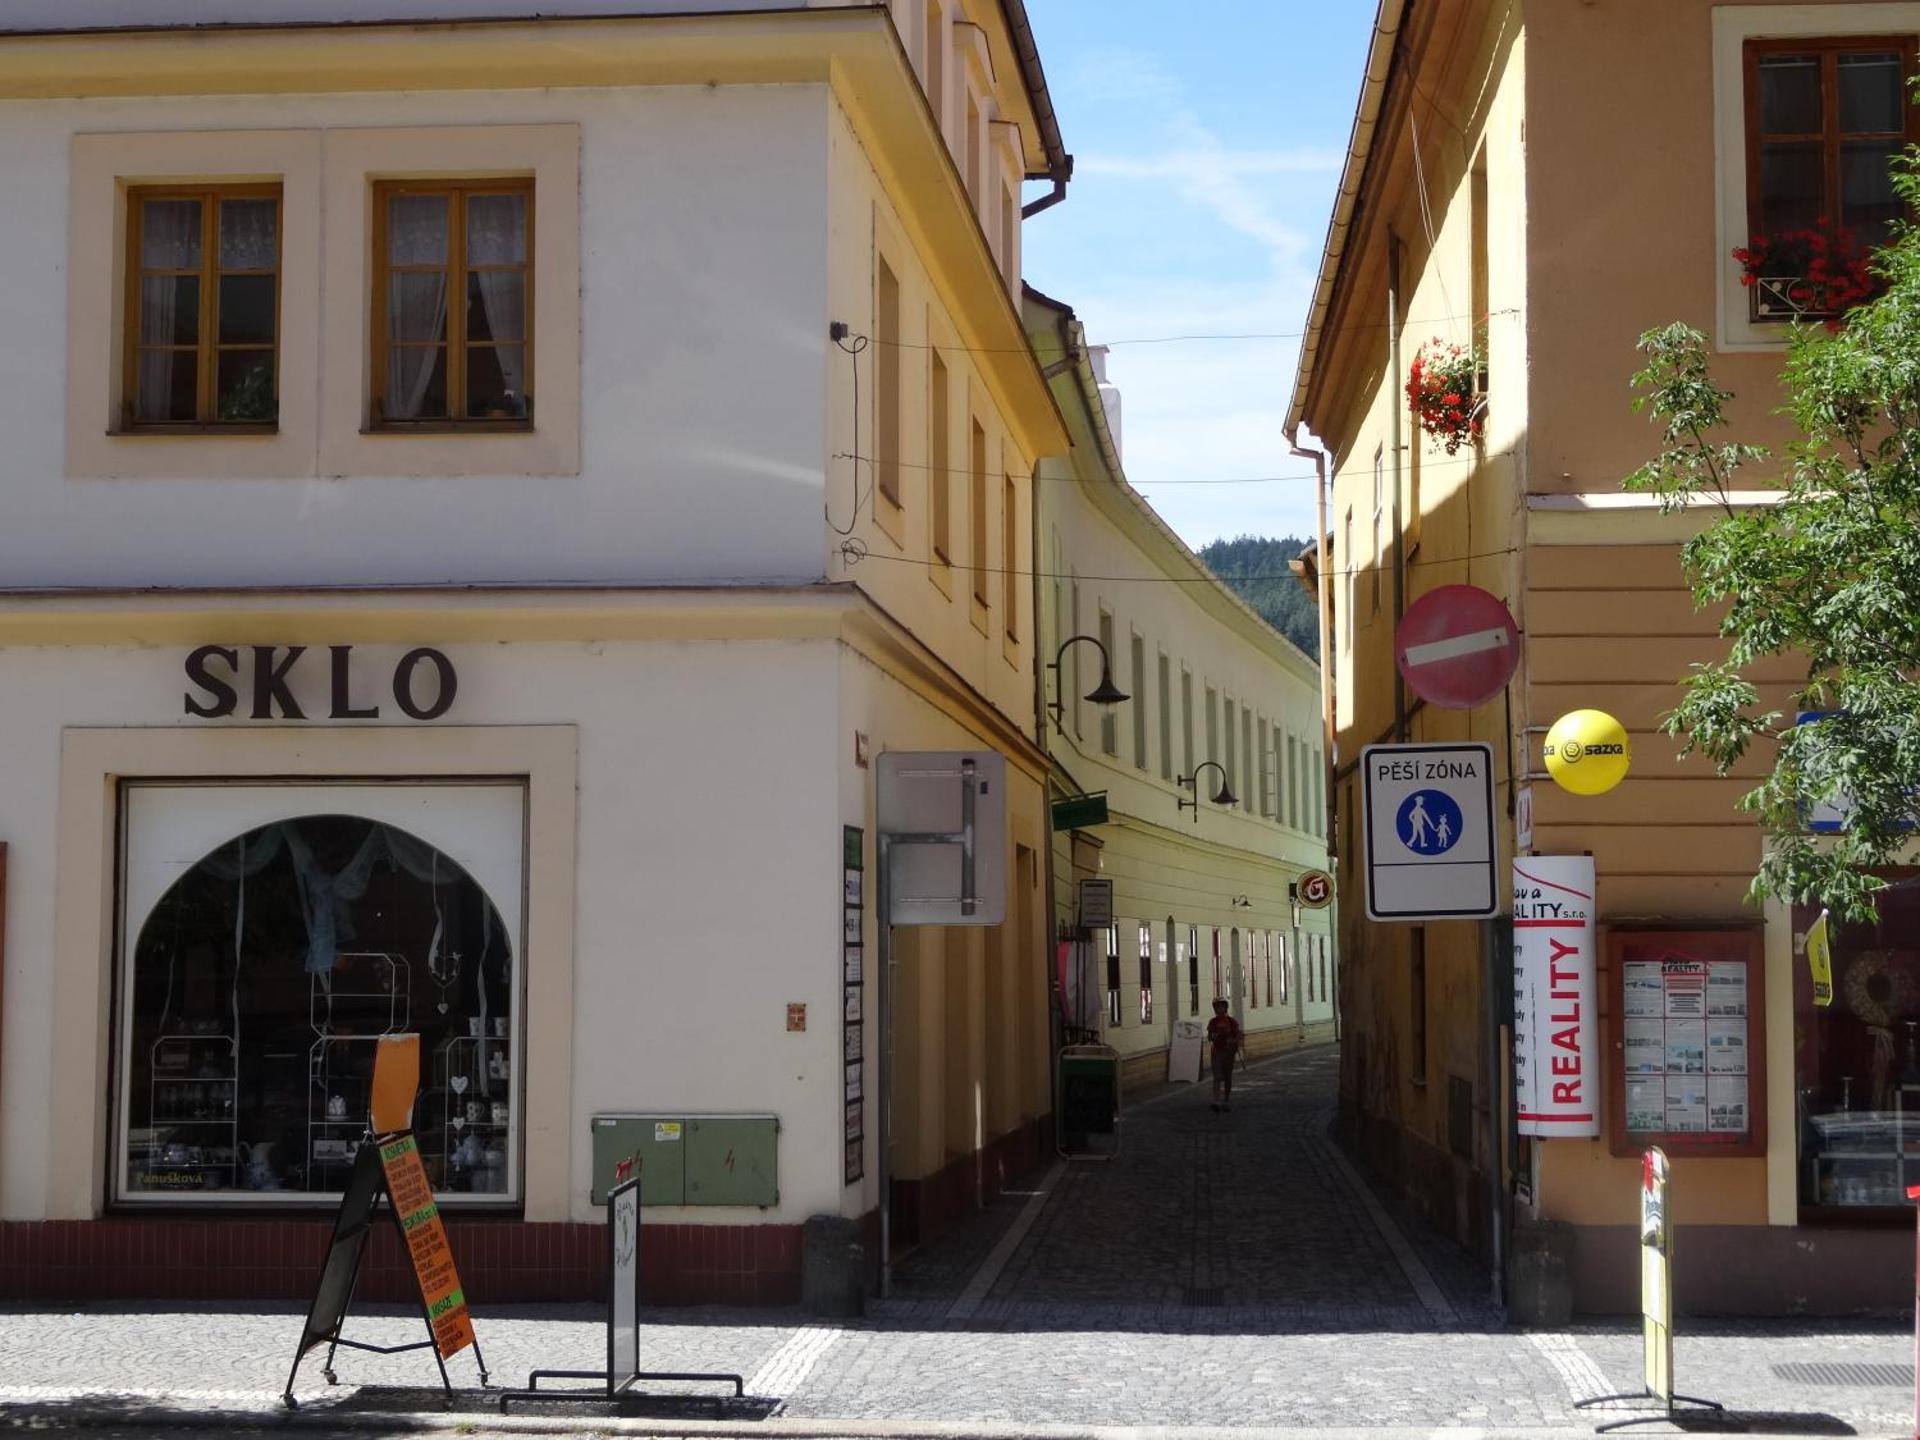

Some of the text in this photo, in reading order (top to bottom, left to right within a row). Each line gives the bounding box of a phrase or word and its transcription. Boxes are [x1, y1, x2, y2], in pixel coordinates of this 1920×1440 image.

[185, 645, 457, 720] SKLO
[1379, 760, 1477, 781] PĚŠÍ ZÓNA
[1549, 937, 1582, 1104] REALITY
